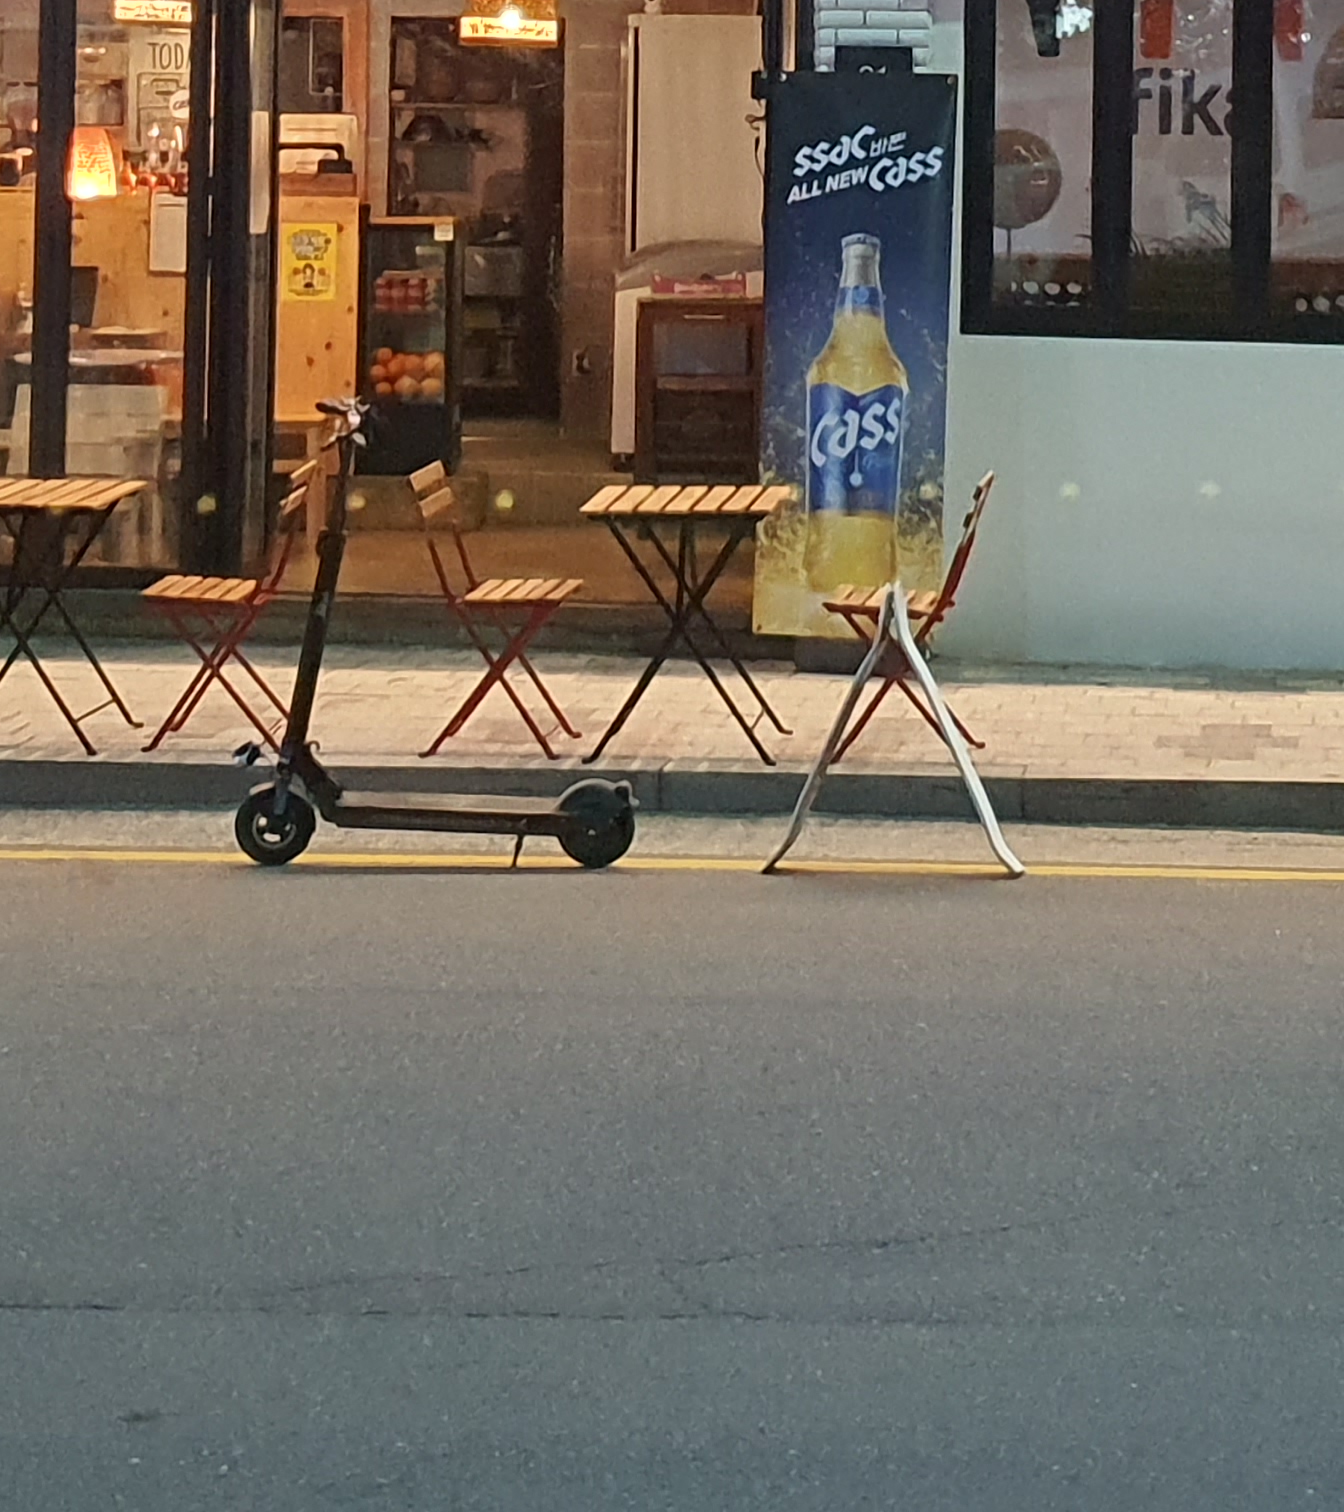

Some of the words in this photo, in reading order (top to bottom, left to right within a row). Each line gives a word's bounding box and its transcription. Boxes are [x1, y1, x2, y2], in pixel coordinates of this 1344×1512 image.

[147, 42, 190, 70] TOD
[787, 179, 822, 204] ALL
[825, 165, 869, 193] NEW
